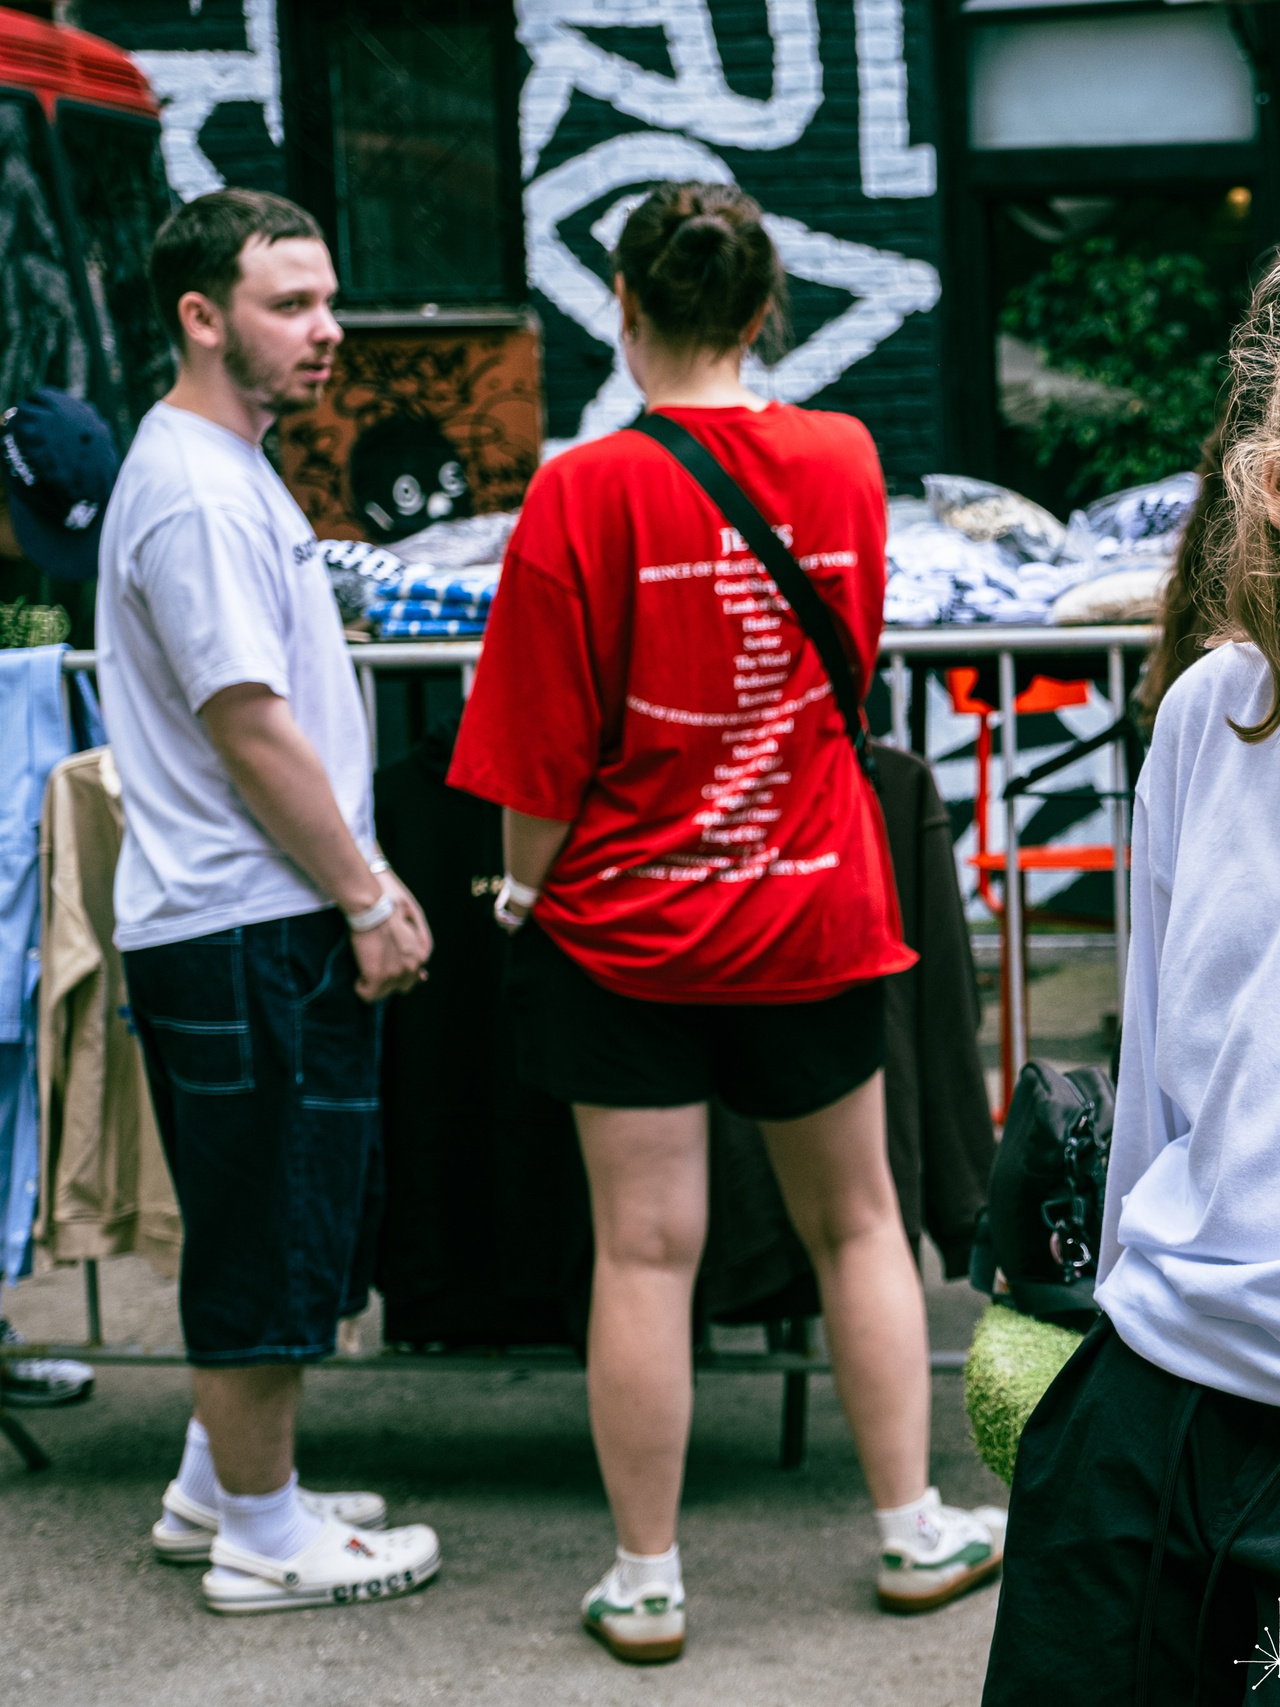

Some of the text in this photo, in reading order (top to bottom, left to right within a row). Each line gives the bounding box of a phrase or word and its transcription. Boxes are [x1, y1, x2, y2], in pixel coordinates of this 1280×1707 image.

[719, 523, 793, 557] JES
[639, 561, 693, 583] PRINCE
[692, 560, 715, 577] OF
[715, 558, 758, 576] PEACE
[333, 1569, 413, 1603] crocs
